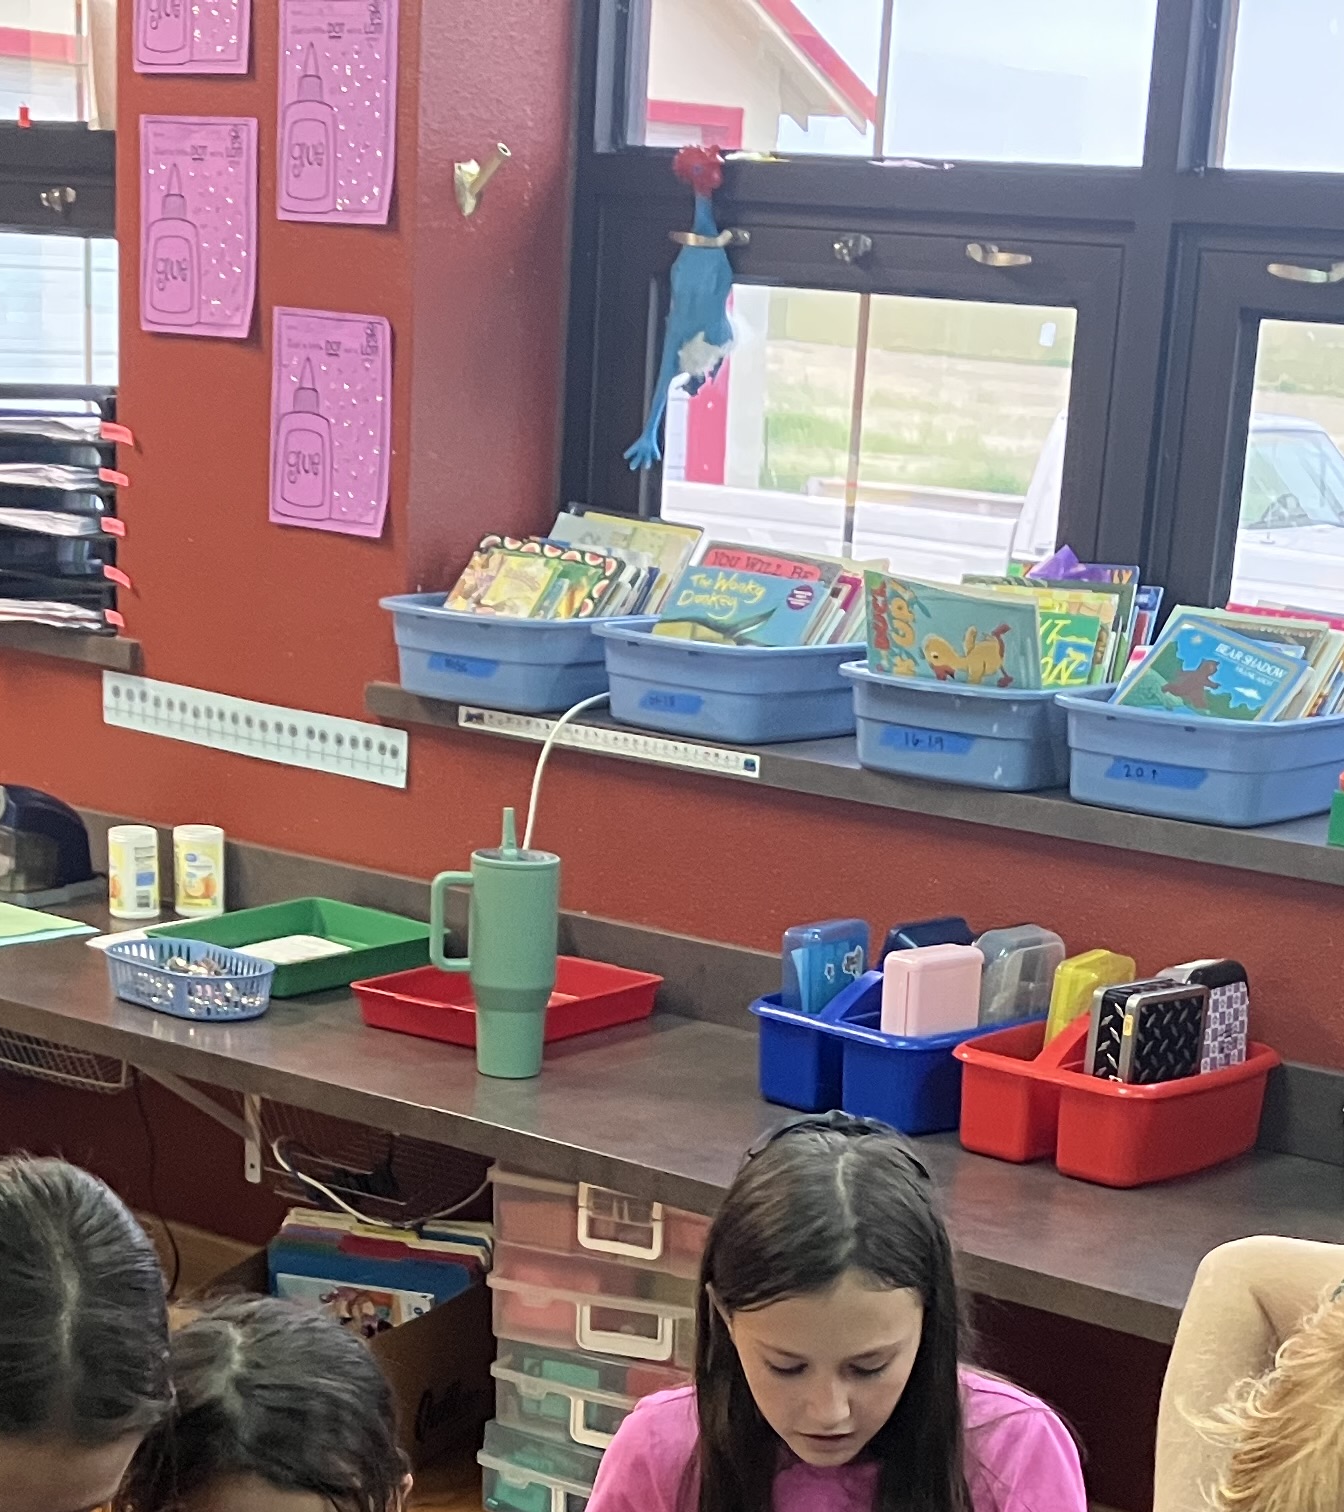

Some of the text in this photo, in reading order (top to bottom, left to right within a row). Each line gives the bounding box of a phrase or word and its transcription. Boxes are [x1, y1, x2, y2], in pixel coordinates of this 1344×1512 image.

[713, 551, 742, 568] YOU
[746, 556, 782, 576] WILL
[1215, 643, 1288, 679] BEAR SHADOW
